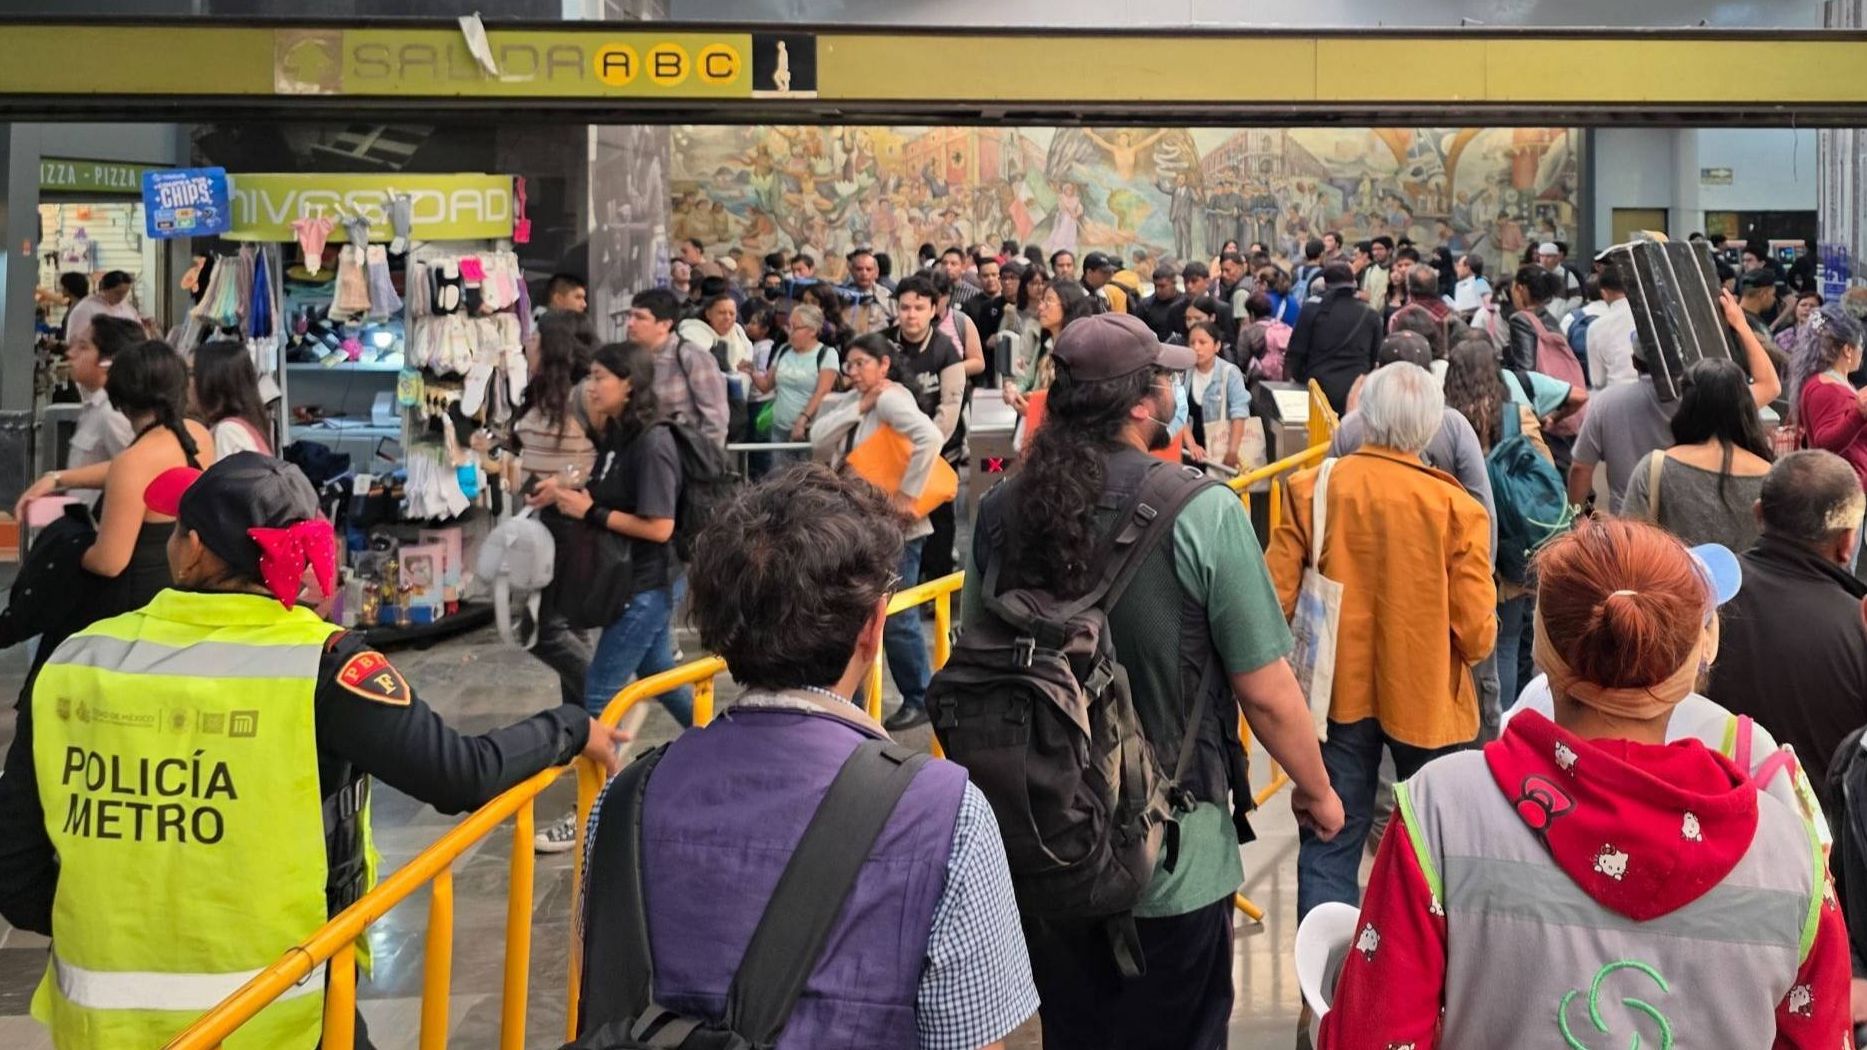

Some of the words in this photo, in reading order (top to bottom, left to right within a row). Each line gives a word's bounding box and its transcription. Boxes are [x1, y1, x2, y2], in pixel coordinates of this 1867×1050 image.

[353, 43, 584, 81] SALDA
[603, 51, 630, 78] A
[655, 52, 681, 78] B
[706, 52, 733, 78] C
[40, 163, 77, 184] IZZA
[94, 166, 136, 188] PIZZA
[160, 182, 212, 208] CHIPS
[62, 746, 238, 800] POLICÍA
[62, 793, 224, 845] METRO
